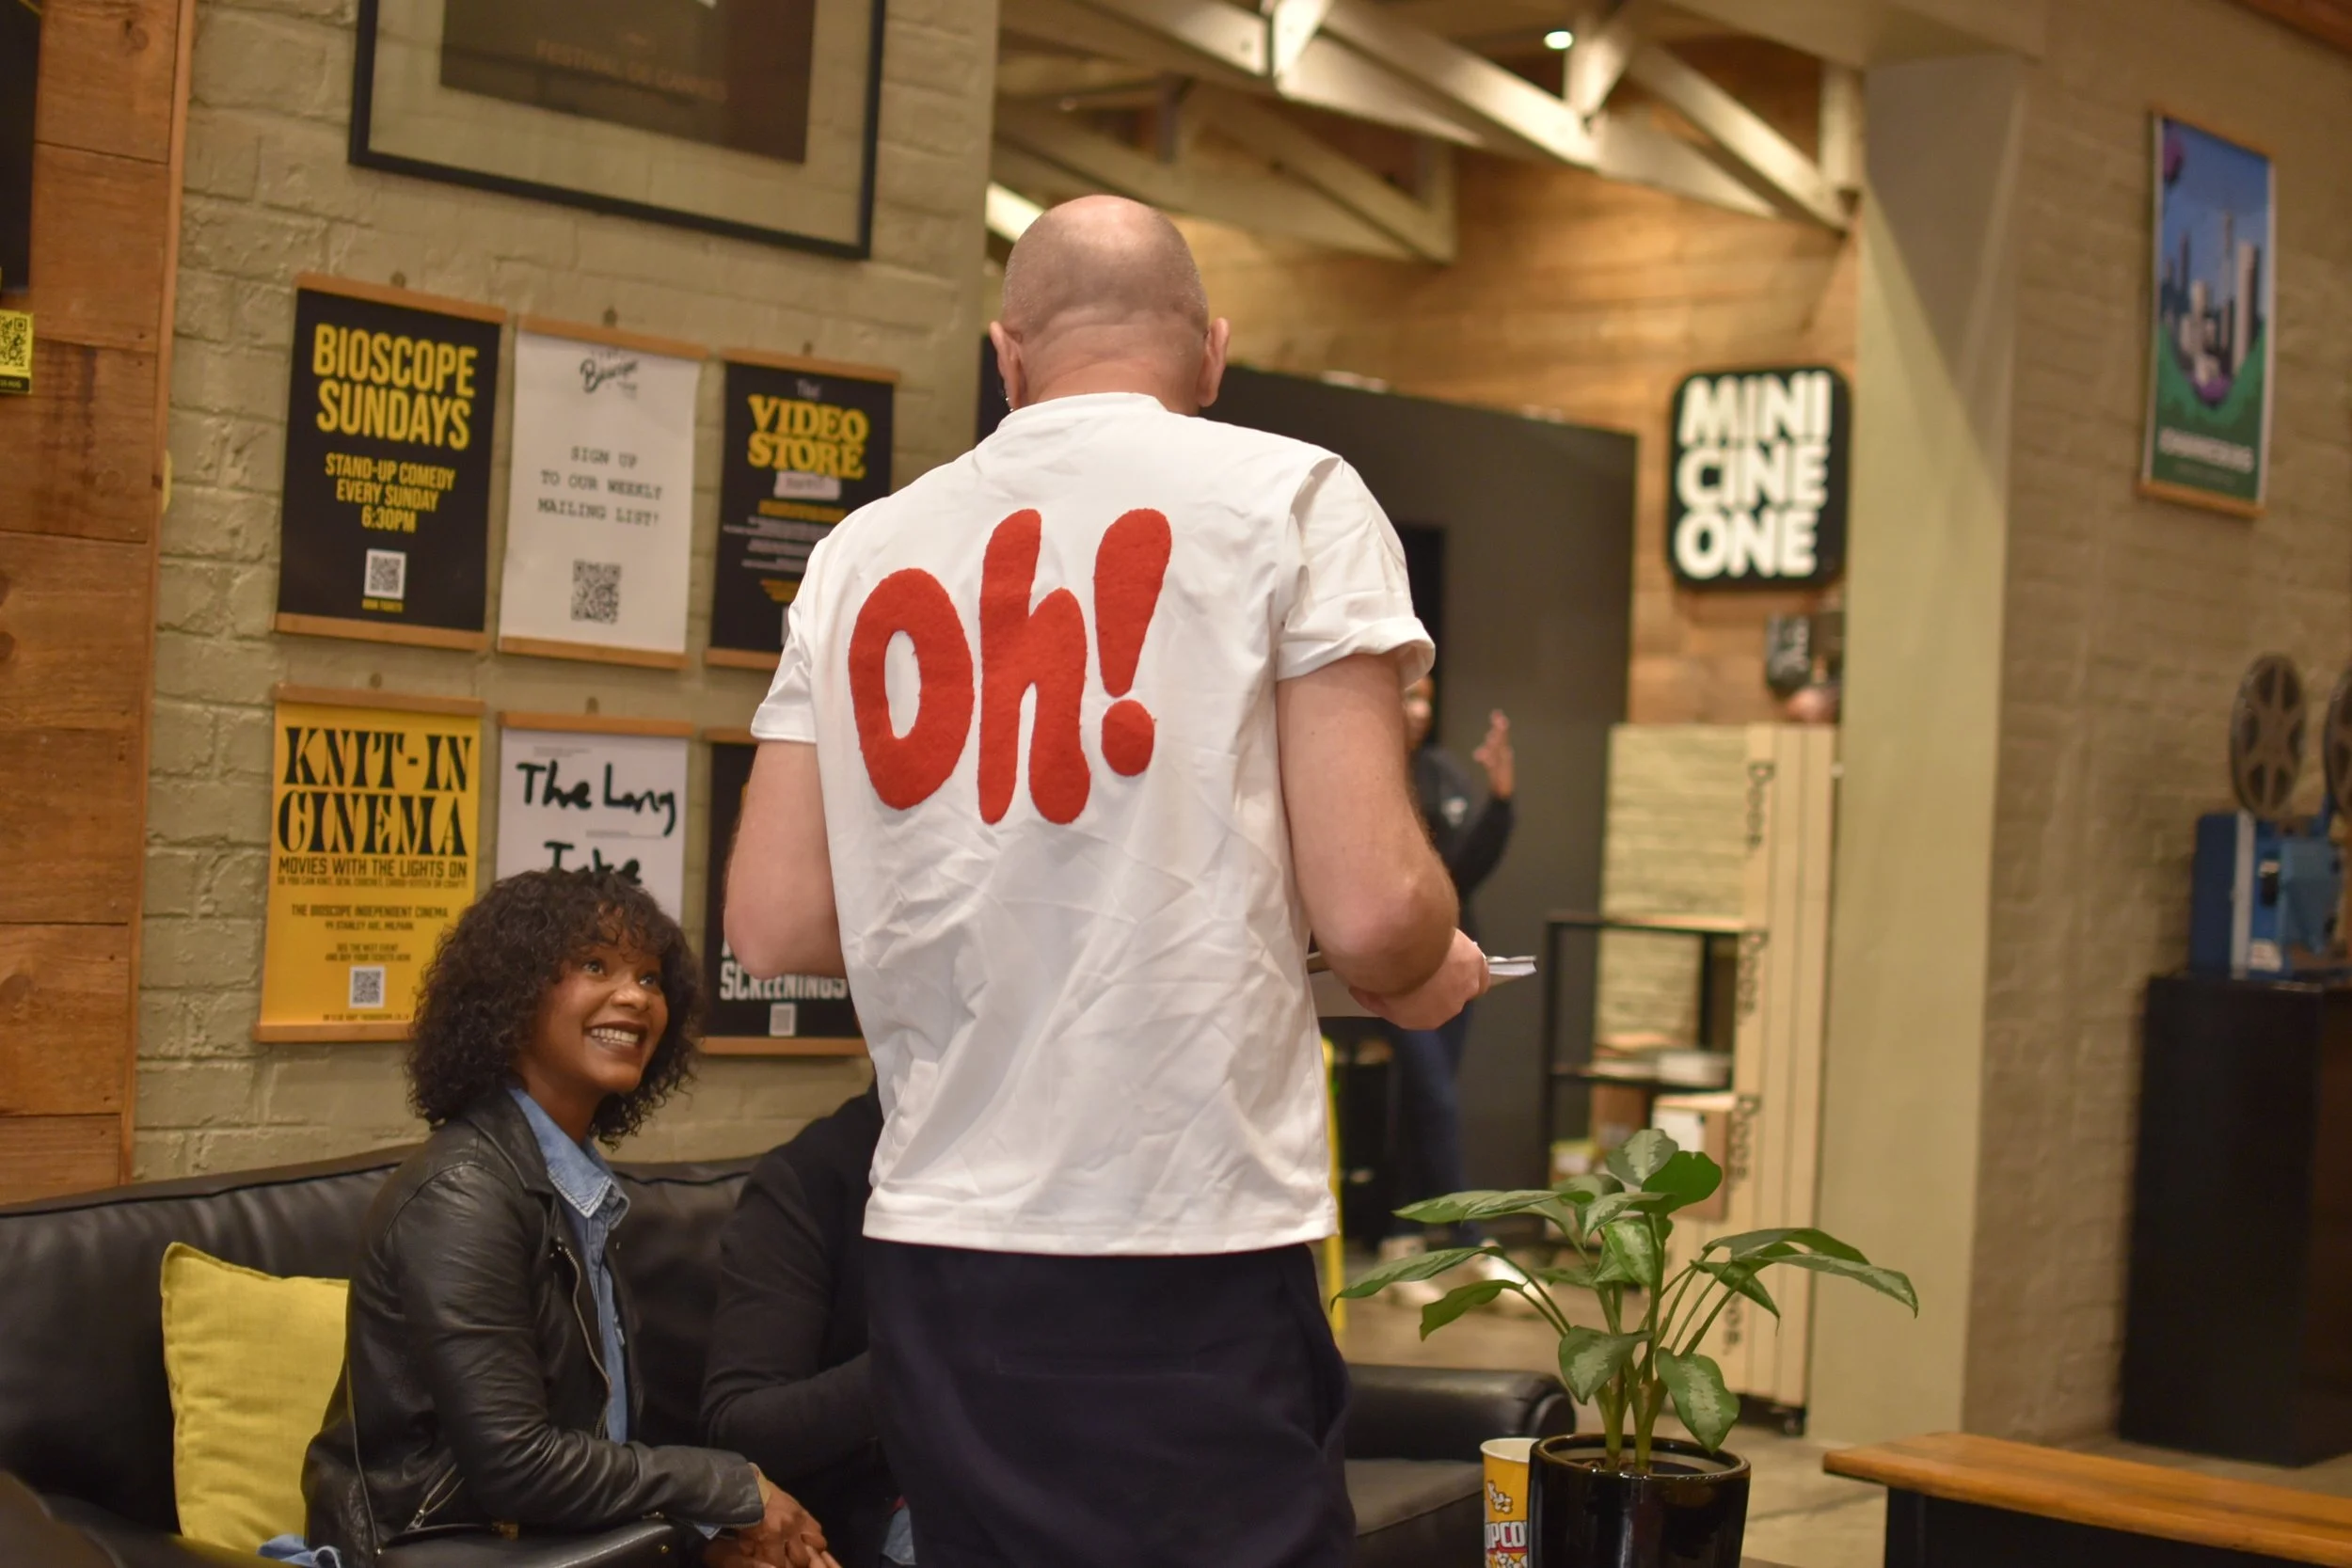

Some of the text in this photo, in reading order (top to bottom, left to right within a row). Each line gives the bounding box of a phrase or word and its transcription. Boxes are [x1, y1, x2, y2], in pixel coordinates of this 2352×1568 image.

[312, 323, 478, 398] BIOSCOPE
[316, 378, 471, 451] SUNDAYS
[748, 393, 870, 444] VIDEO
[1679, 370, 1831, 447] MINI
[326, 452, 456, 491] STAND-UP COMEDY
[571, 445, 639, 469] SIGN UP
[747, 431, 866, 481] STORE
[1677, 443, 1829, 511] CINE
[336, 478, 439, 513] EVERY SUNDAY
[541, 469, 663, 501] TO OUR WEEKLY
[360, 504, 417, 533] 6:30PM
[537, 497, 661, 528] MAILING LIST!
[1674, 506, 1818, 580] ONE
[283, 726, 473, 793] KNIT-IN
[278, 789, 469, 857] CINEMA
[516, 759, 677, 837] The Long
[278, 856, 468, 879] MOVIES WITH THE LIGHTS ON
[544, 840, 643, 887] Tke
[292, 904, 449, 919] THE BIOSCOPE INDEPENDENT CINEMA
